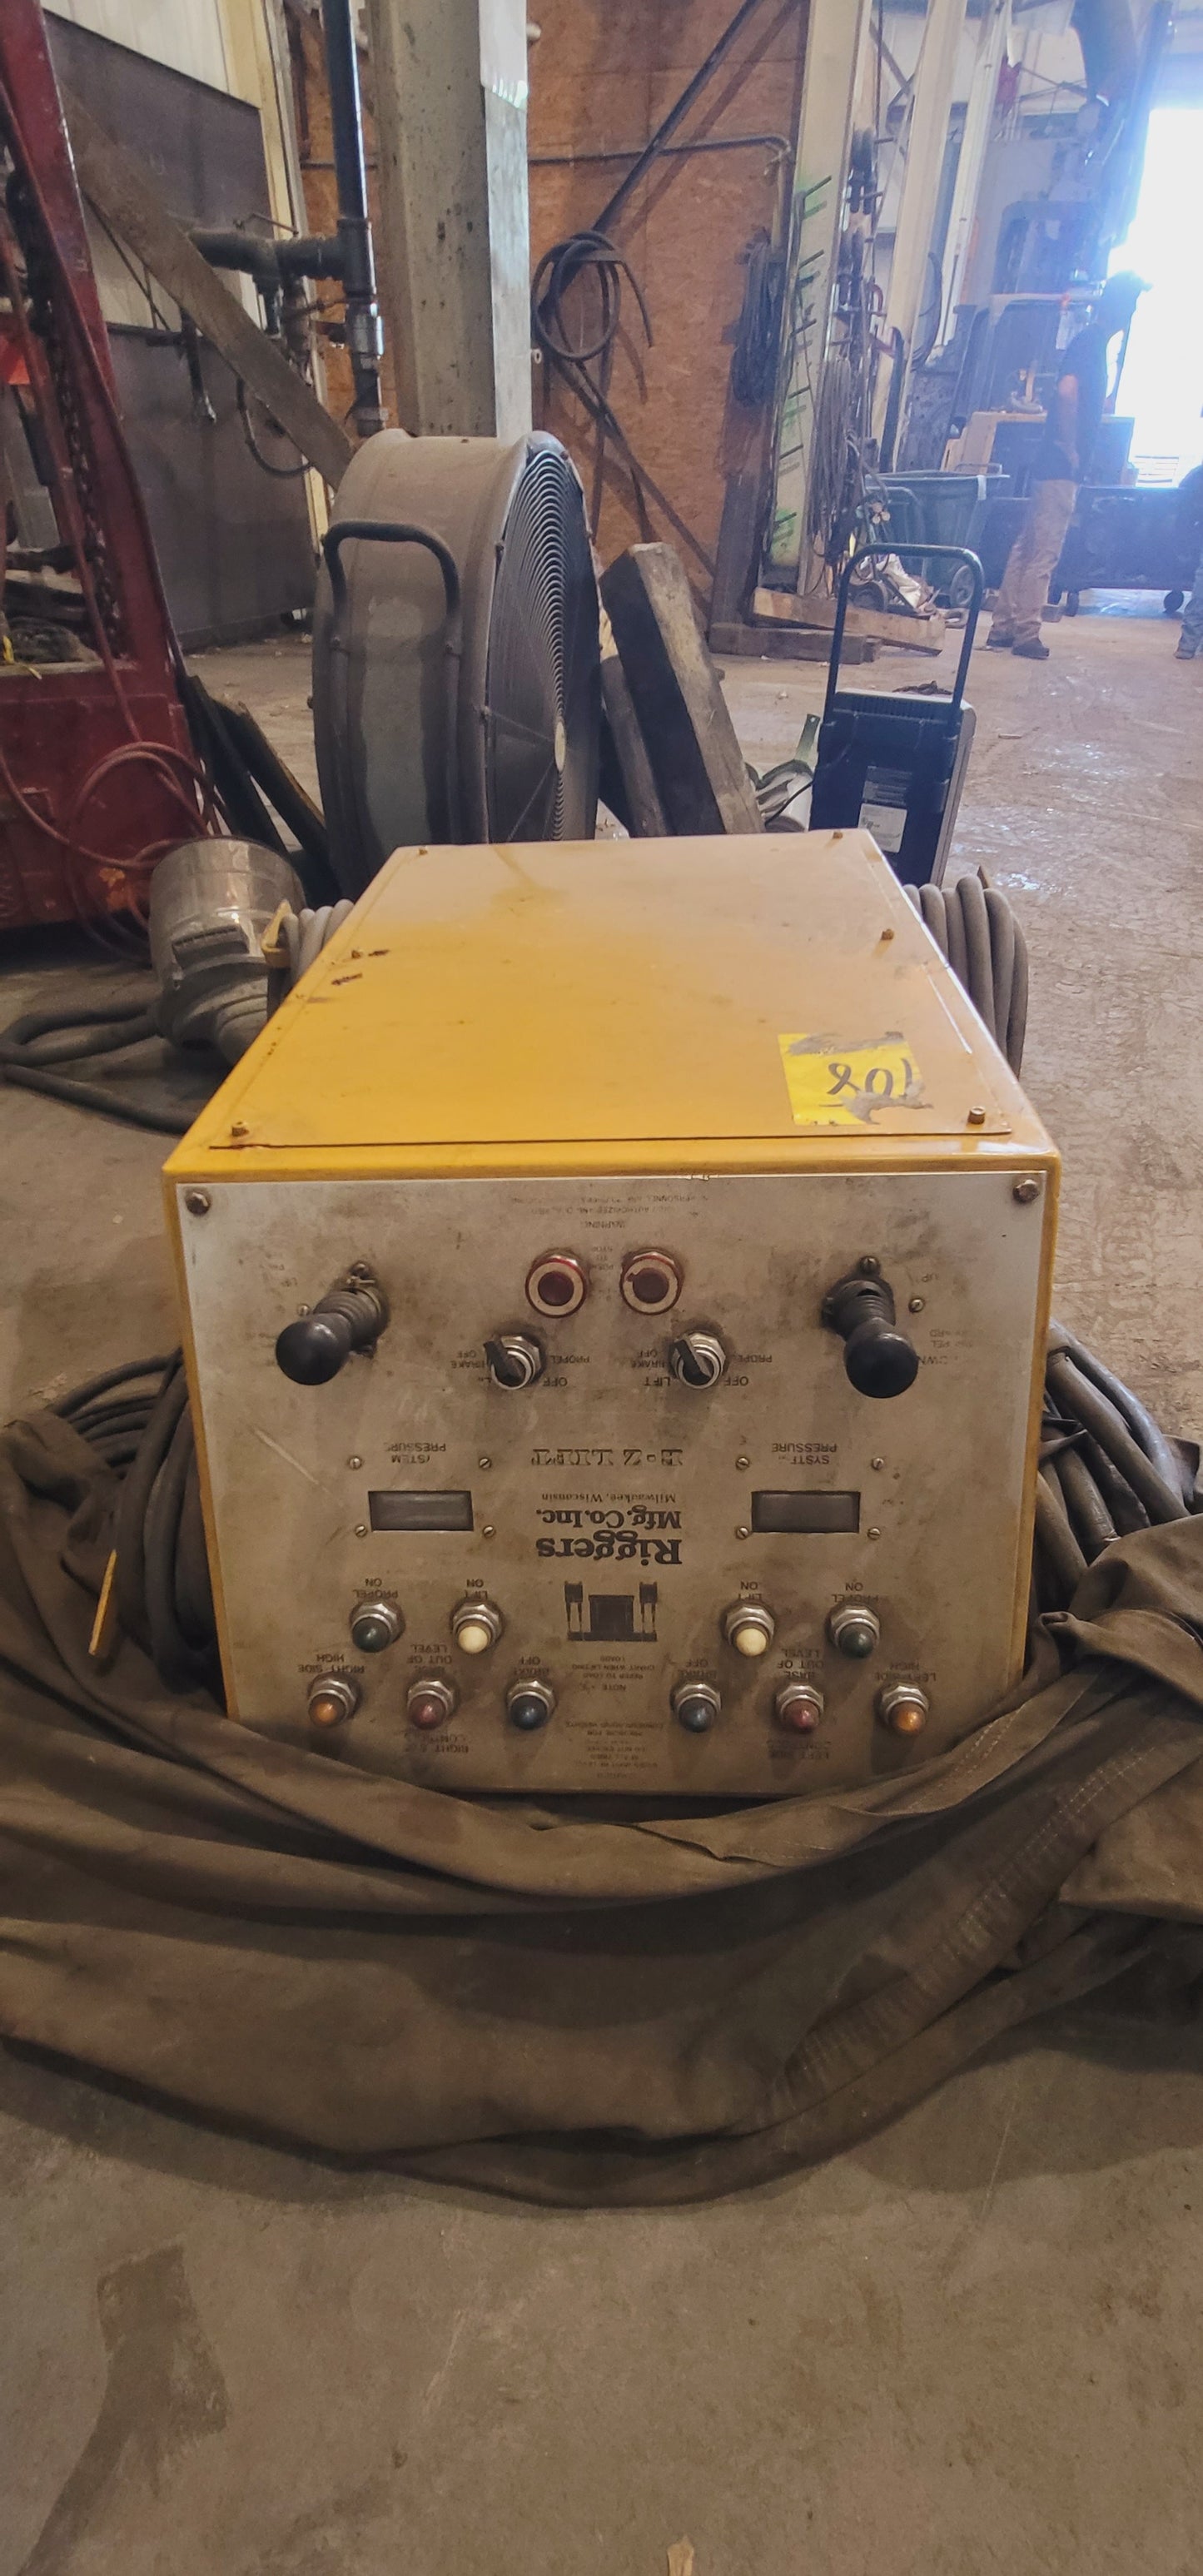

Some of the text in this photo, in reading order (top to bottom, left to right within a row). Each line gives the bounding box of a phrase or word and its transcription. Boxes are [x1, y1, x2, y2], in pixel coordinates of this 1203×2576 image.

[637, 1350, 657, 1358] OFF
[549, 1355, 590, 1364] PROPEL
[629, 1360, 665, 1368] BRAKE
[542, 1377, 568, 1386] OFF
[644, 1376, 671, 1386] LIFT
[724, 1376, 749, 1386] OFF
[771, 1443, 838, 1453] PRESSURE
[530, 1449, 684, 1466] E-Z LIFT
[542, 1493, 676, 1504] Milwaukee, Wisconsin
[535, 1529, 683, 1566] Riggers
[365, 1578, 382, 1587] ON
[466, 1579, 485, 1588] ON
[740, 1581, 758, 1591] ON
[845, 1583, 863, 1592] ON
[352, 1589, 398, 1599] PROPEL
[781, 1649, 819, 1658] LEVEL
[316, 1654, 345, 1663] HIGH
[406, 1655, 452, 1663] OUT OF
[686, 1658, 708, 1668] OFF
[297, 1664, 323, 1673] SIDE
[777, 1660, 824, 1668] OUT OF
